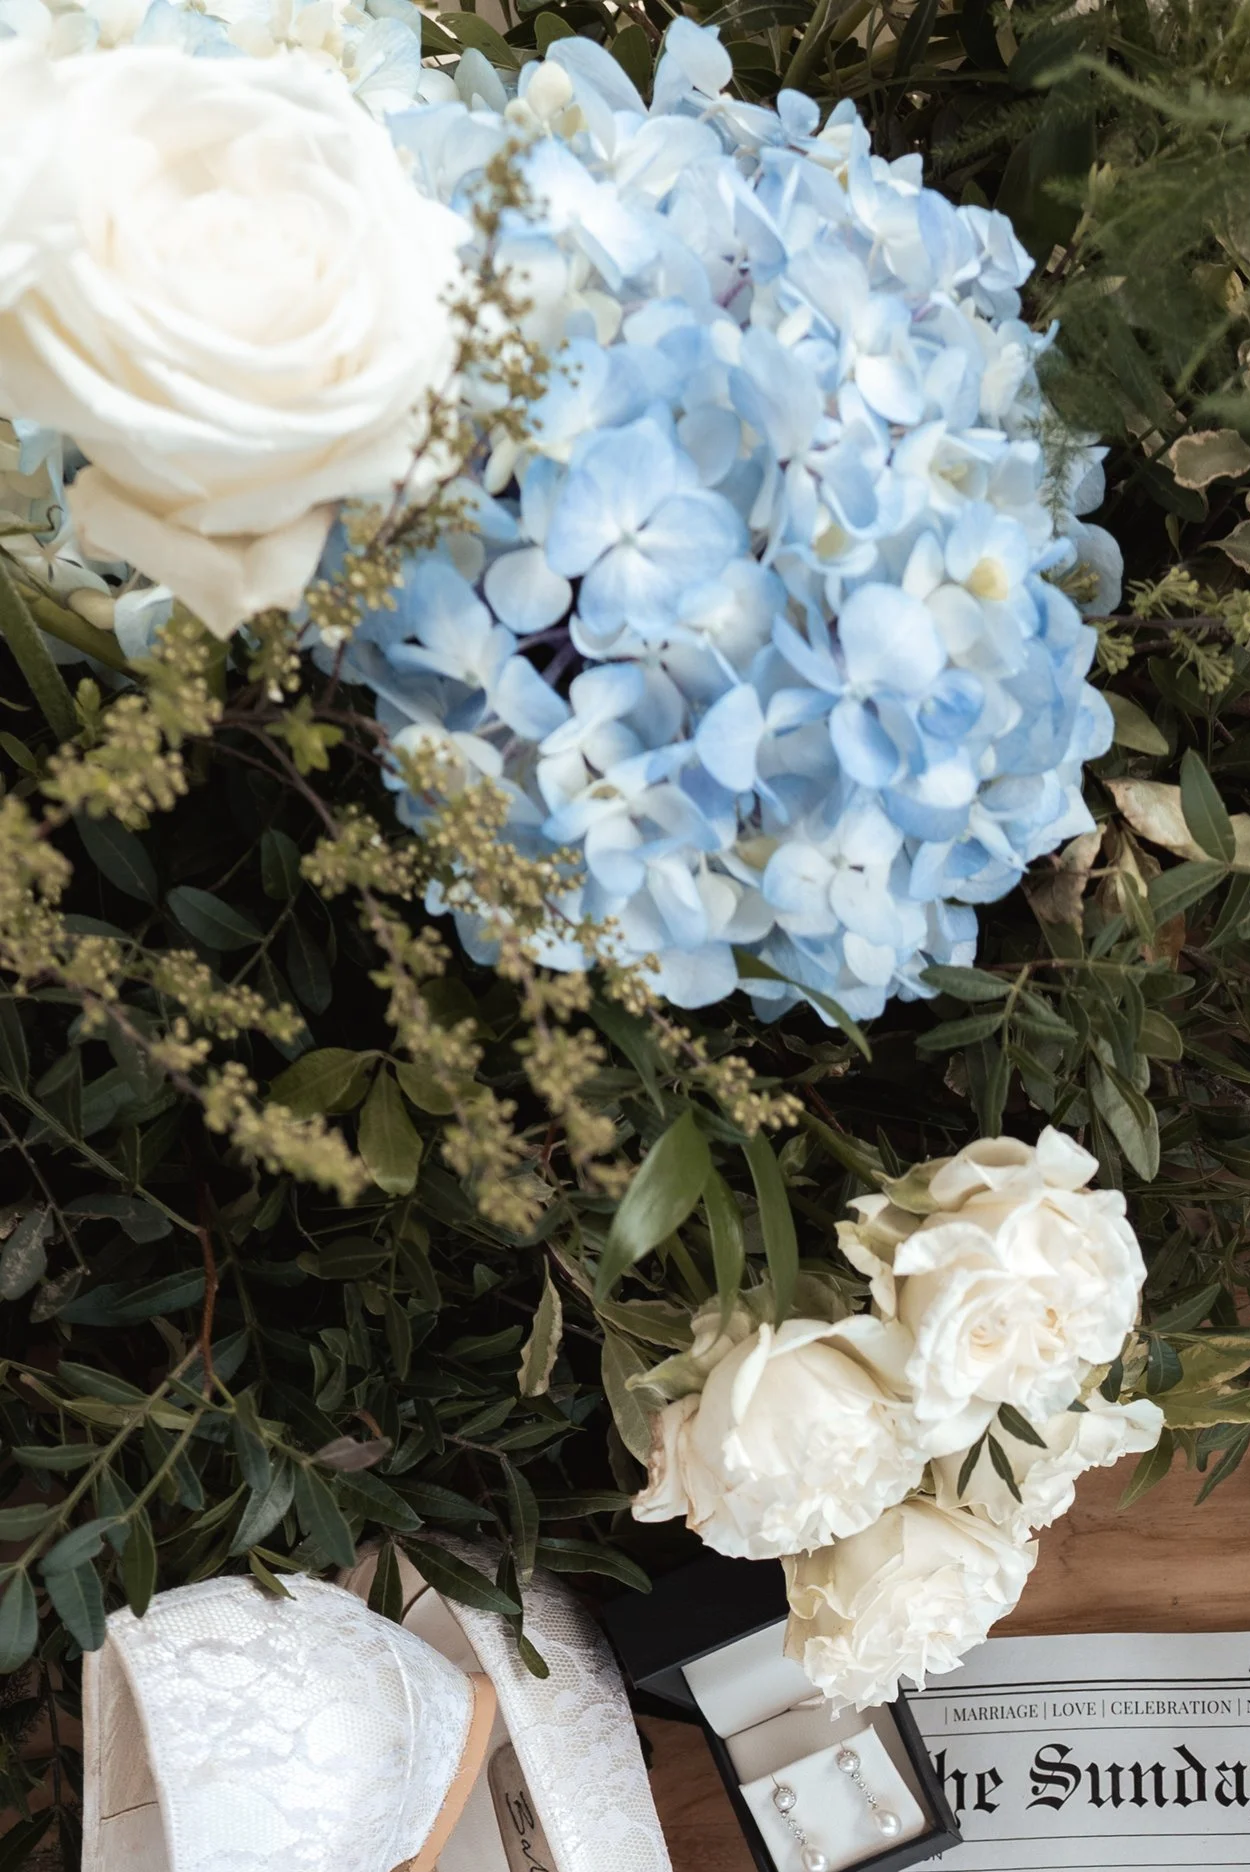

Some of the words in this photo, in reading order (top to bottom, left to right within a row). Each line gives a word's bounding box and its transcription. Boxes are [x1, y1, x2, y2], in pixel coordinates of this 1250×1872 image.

[954, 1705, 1038, 1722] MARRIAGE
[1053, 1702, 1096, 1716] LOVE
[1111, 1700, 1231, 1714] CELEBRATION
[927, 1748, 1004, 1829] he
